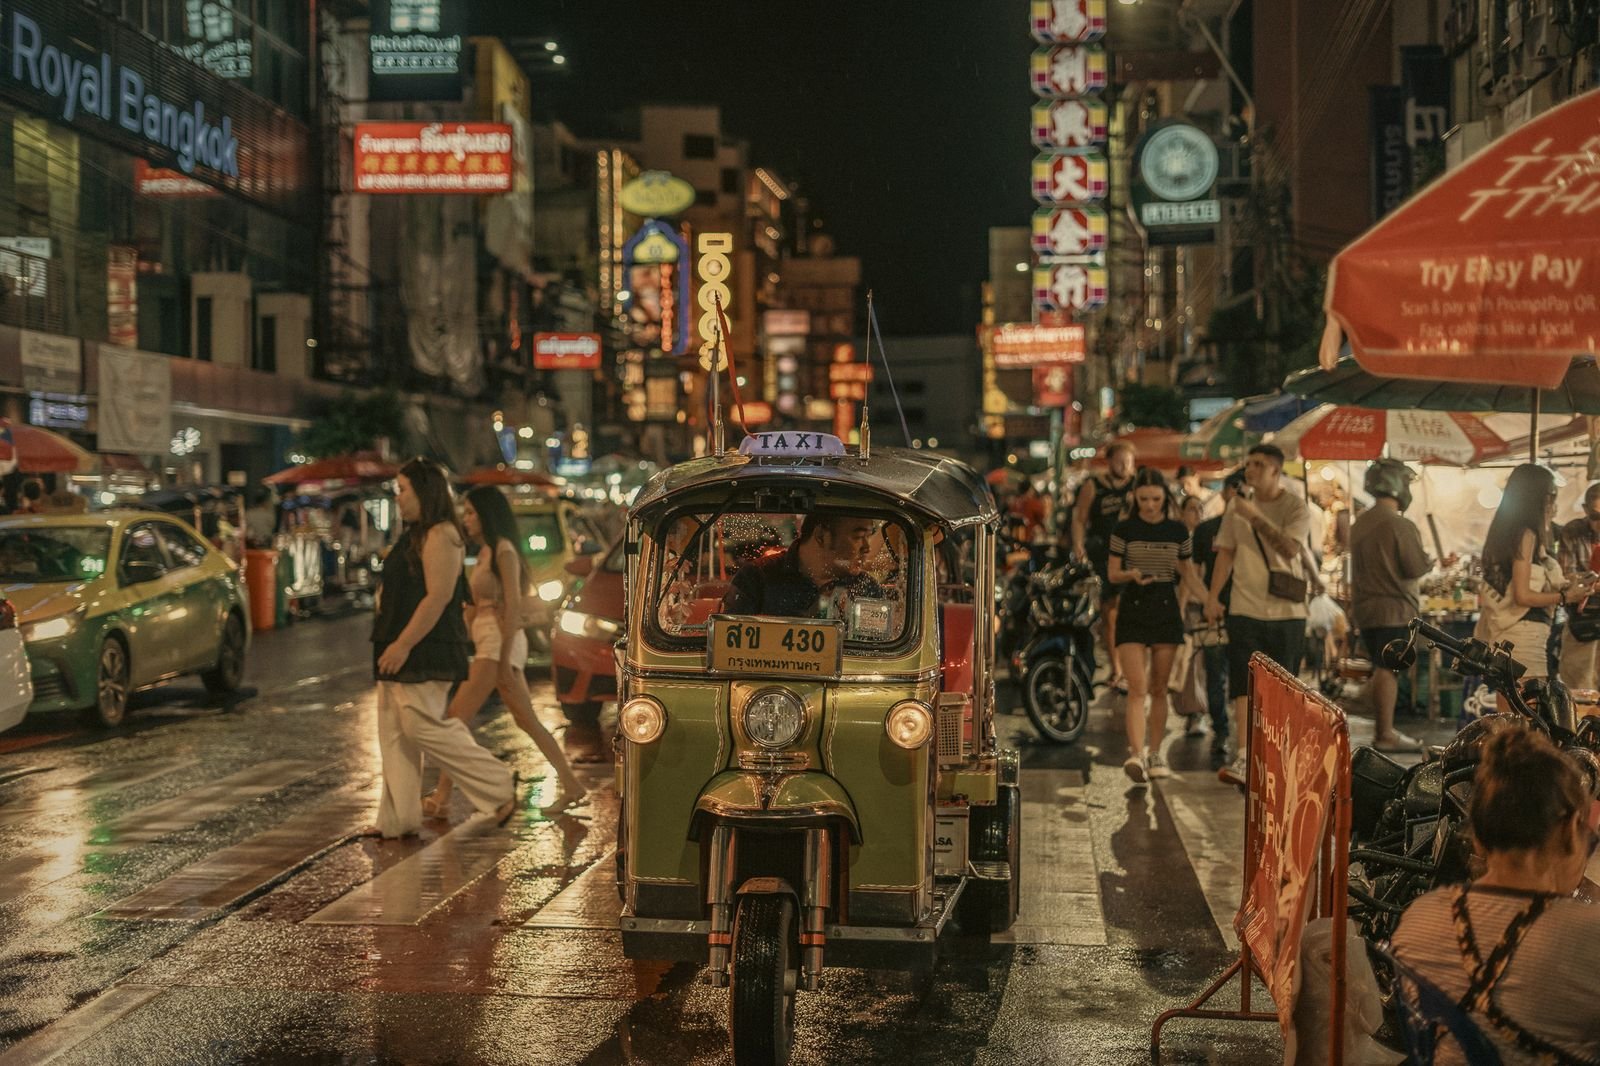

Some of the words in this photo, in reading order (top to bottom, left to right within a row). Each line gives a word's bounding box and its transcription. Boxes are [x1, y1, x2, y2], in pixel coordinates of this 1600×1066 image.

[12, 11, 112, 122] Royal
[119, 66, 239, 177] Bangkok
[1419, 259, 1459, 293] Try
[1463, 256, 1523, 290] Easy
[1530, 253, 1583, 290] Pay
[1401, 301, 1428, 316] Scan
[1442, 302, 1463, 317] pay
[759, 433, 824, 449] TAXI
[726, 623, 761, 650] สข
[781, 628, 825, 653] 430
[727, 656, 821, 672] กรุงเทพมหานคร
[935, 836, 953, 847] SA
